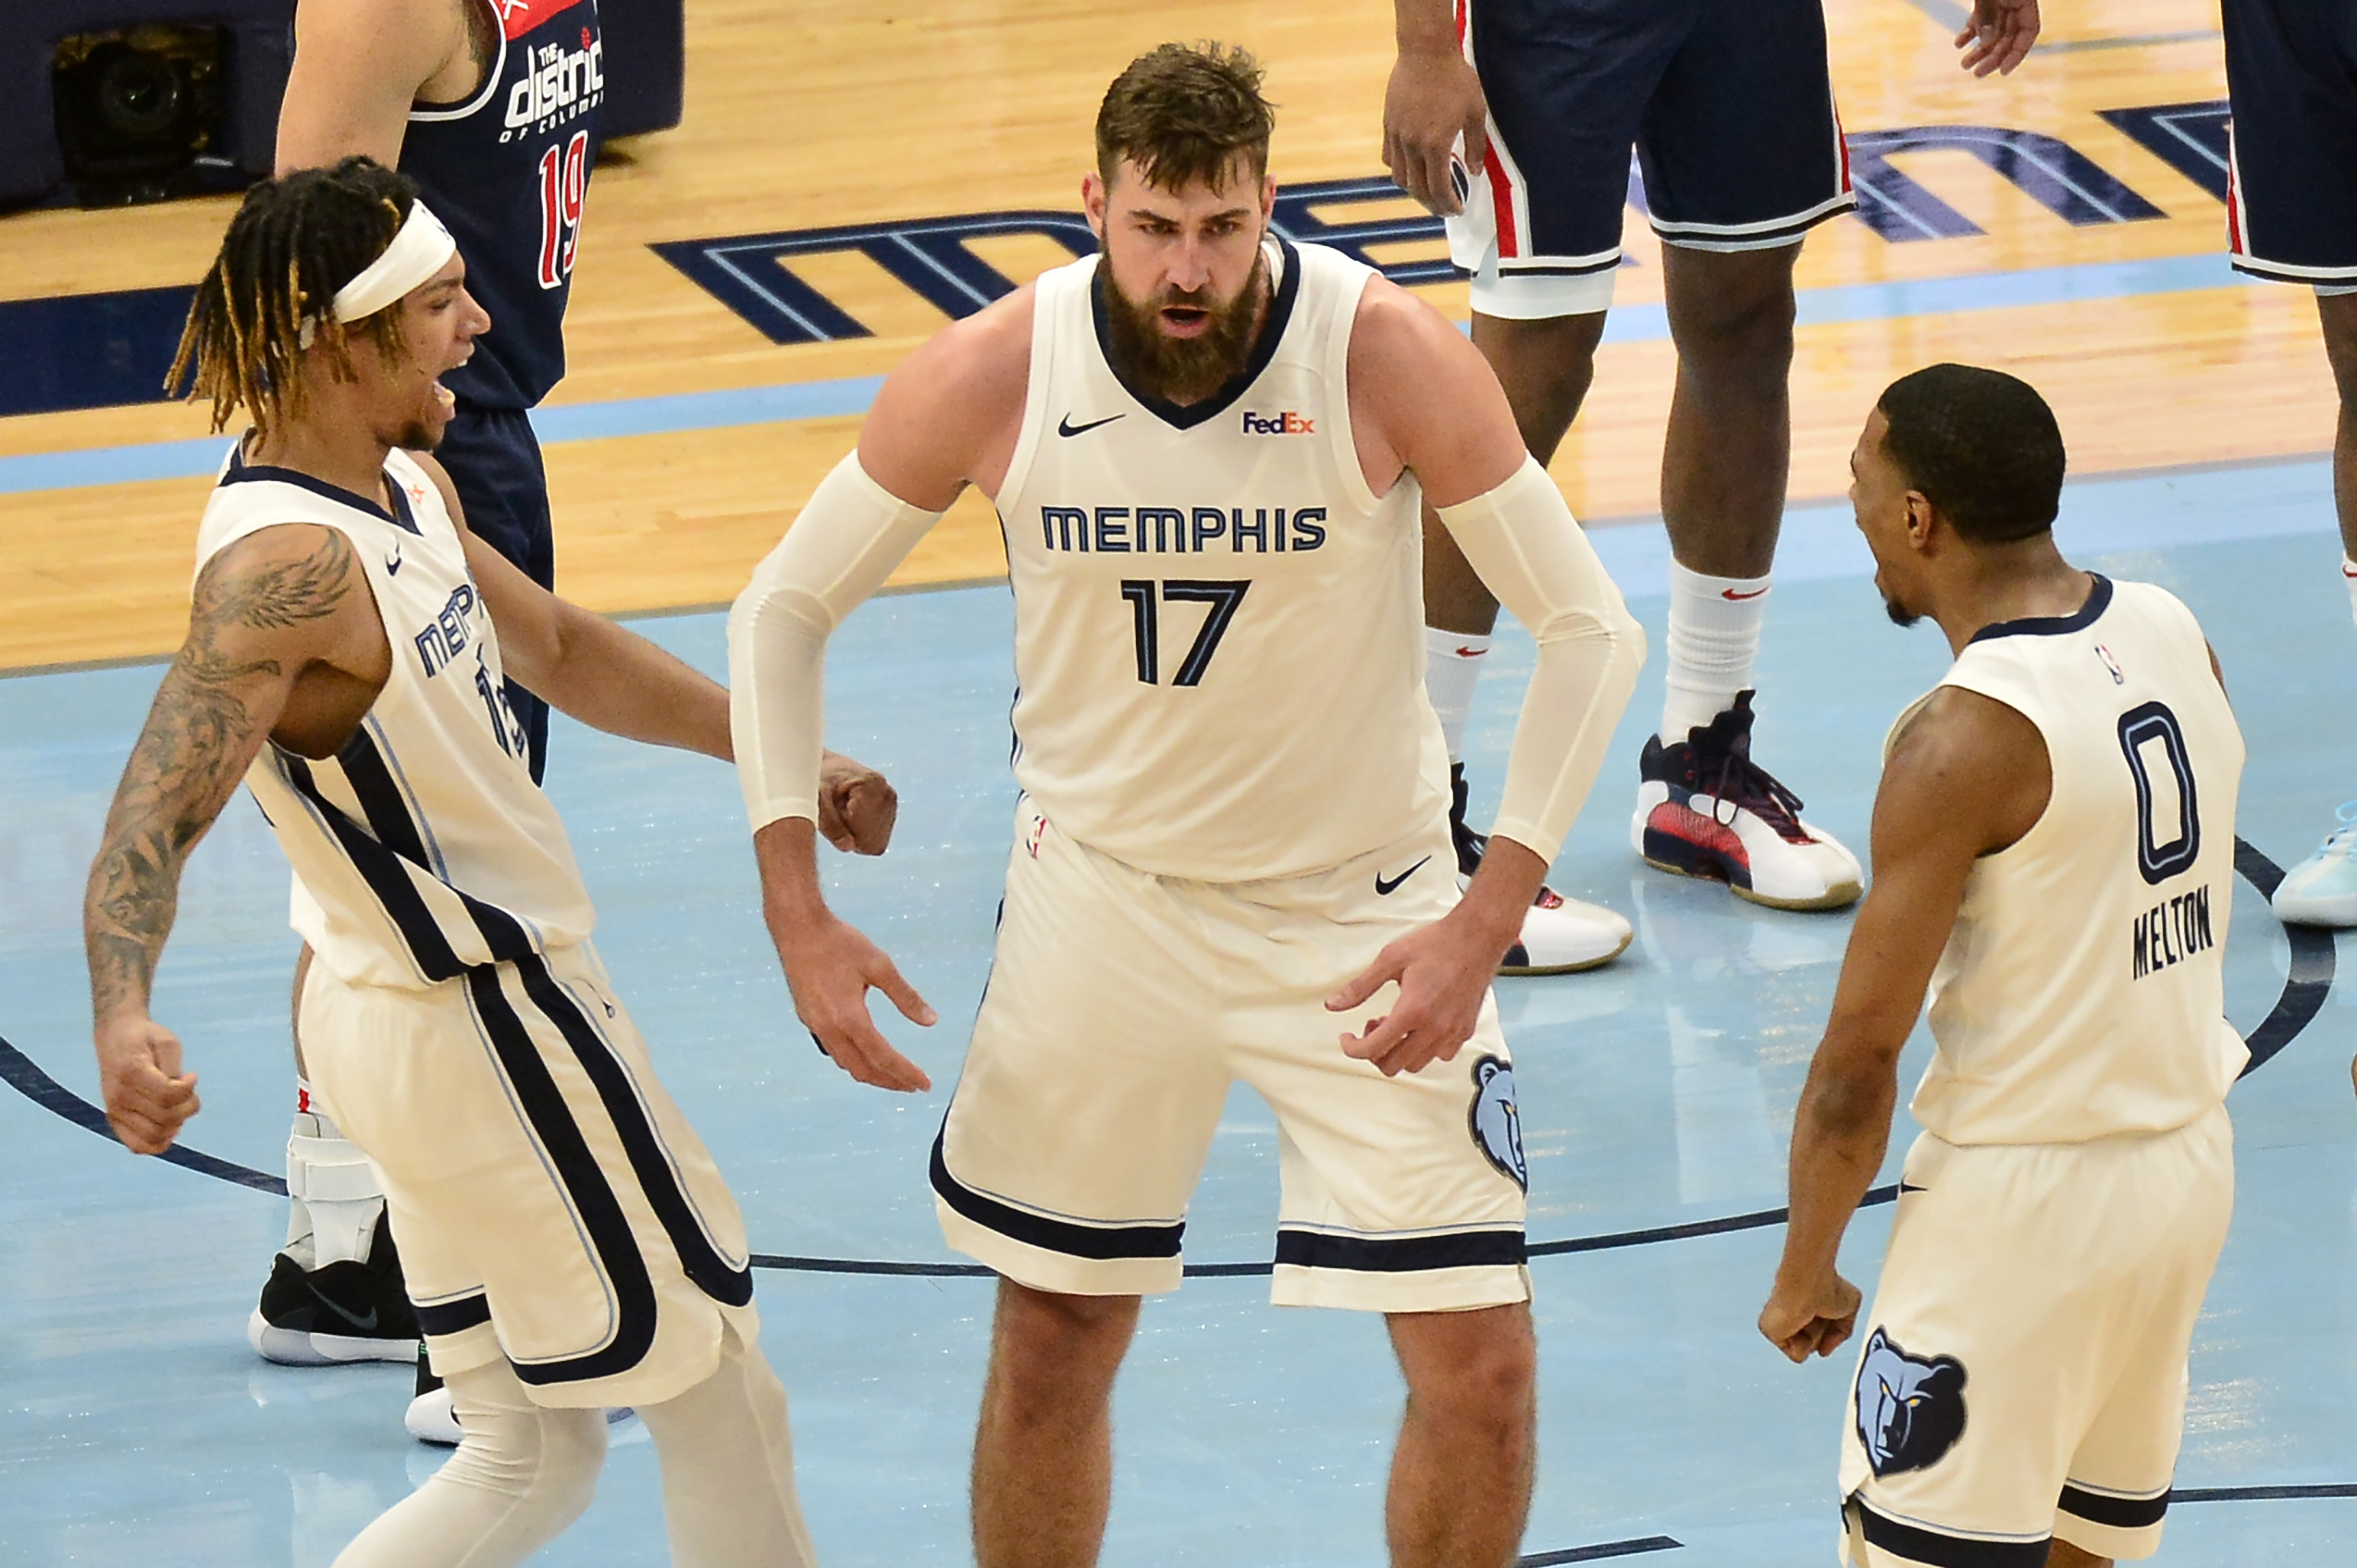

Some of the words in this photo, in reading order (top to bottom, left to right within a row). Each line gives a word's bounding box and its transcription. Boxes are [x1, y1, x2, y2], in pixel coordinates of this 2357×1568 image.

[504, 27, 604, 128] distric
[538, 42, 558, 67] THE
[499, 127, 528, 143] OF
[538, 90, 604, 134] COLUMBI
[538, 129, 588, 290] 19
[1243, 411, 1315, 434] FedEx
[1041, 505, 1328, 553] MEMPHIS
[1120, 579, 1252, 686] 17
[2117, 701, 2200, 886] 0
[2133, 884, 2213, 981] MELTON
